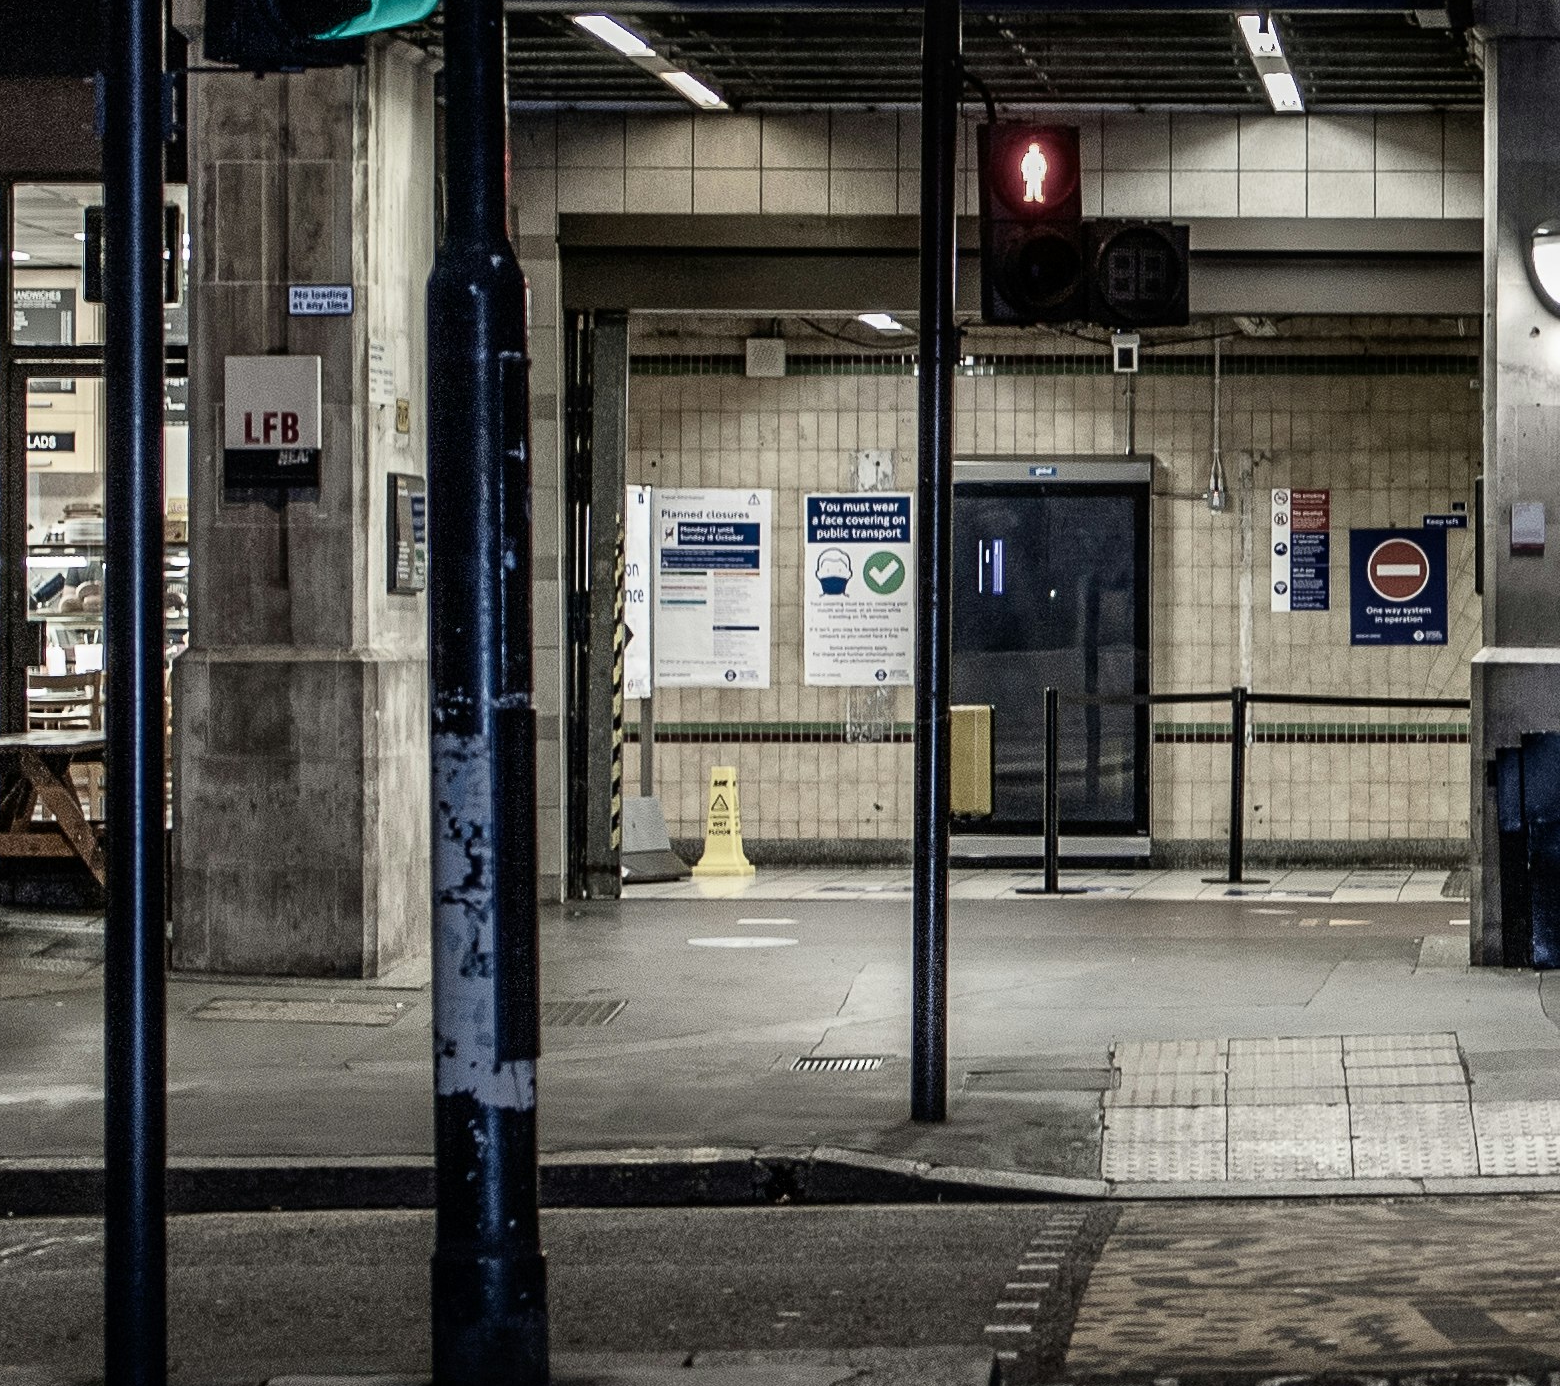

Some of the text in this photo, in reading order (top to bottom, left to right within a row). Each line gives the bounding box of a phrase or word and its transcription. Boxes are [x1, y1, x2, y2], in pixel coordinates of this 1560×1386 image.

[294, 290, 348, 302] No loading
[244, 412, 300, 444] LFB
[819, 501, 899, 512] You must wear
[661, 510, 750, 519] Planned closures
[812, 514, 906, 528] a face covering on
[1426, 518, 1444, 527] Keep
[680, 526, 708, 535] Monday
[816, 527, 902, 541] public transport
[715, 534, 744, 542] October
[1366, 606, 1432, 616] One way system
[1385, 616, 1422, 625] operation
